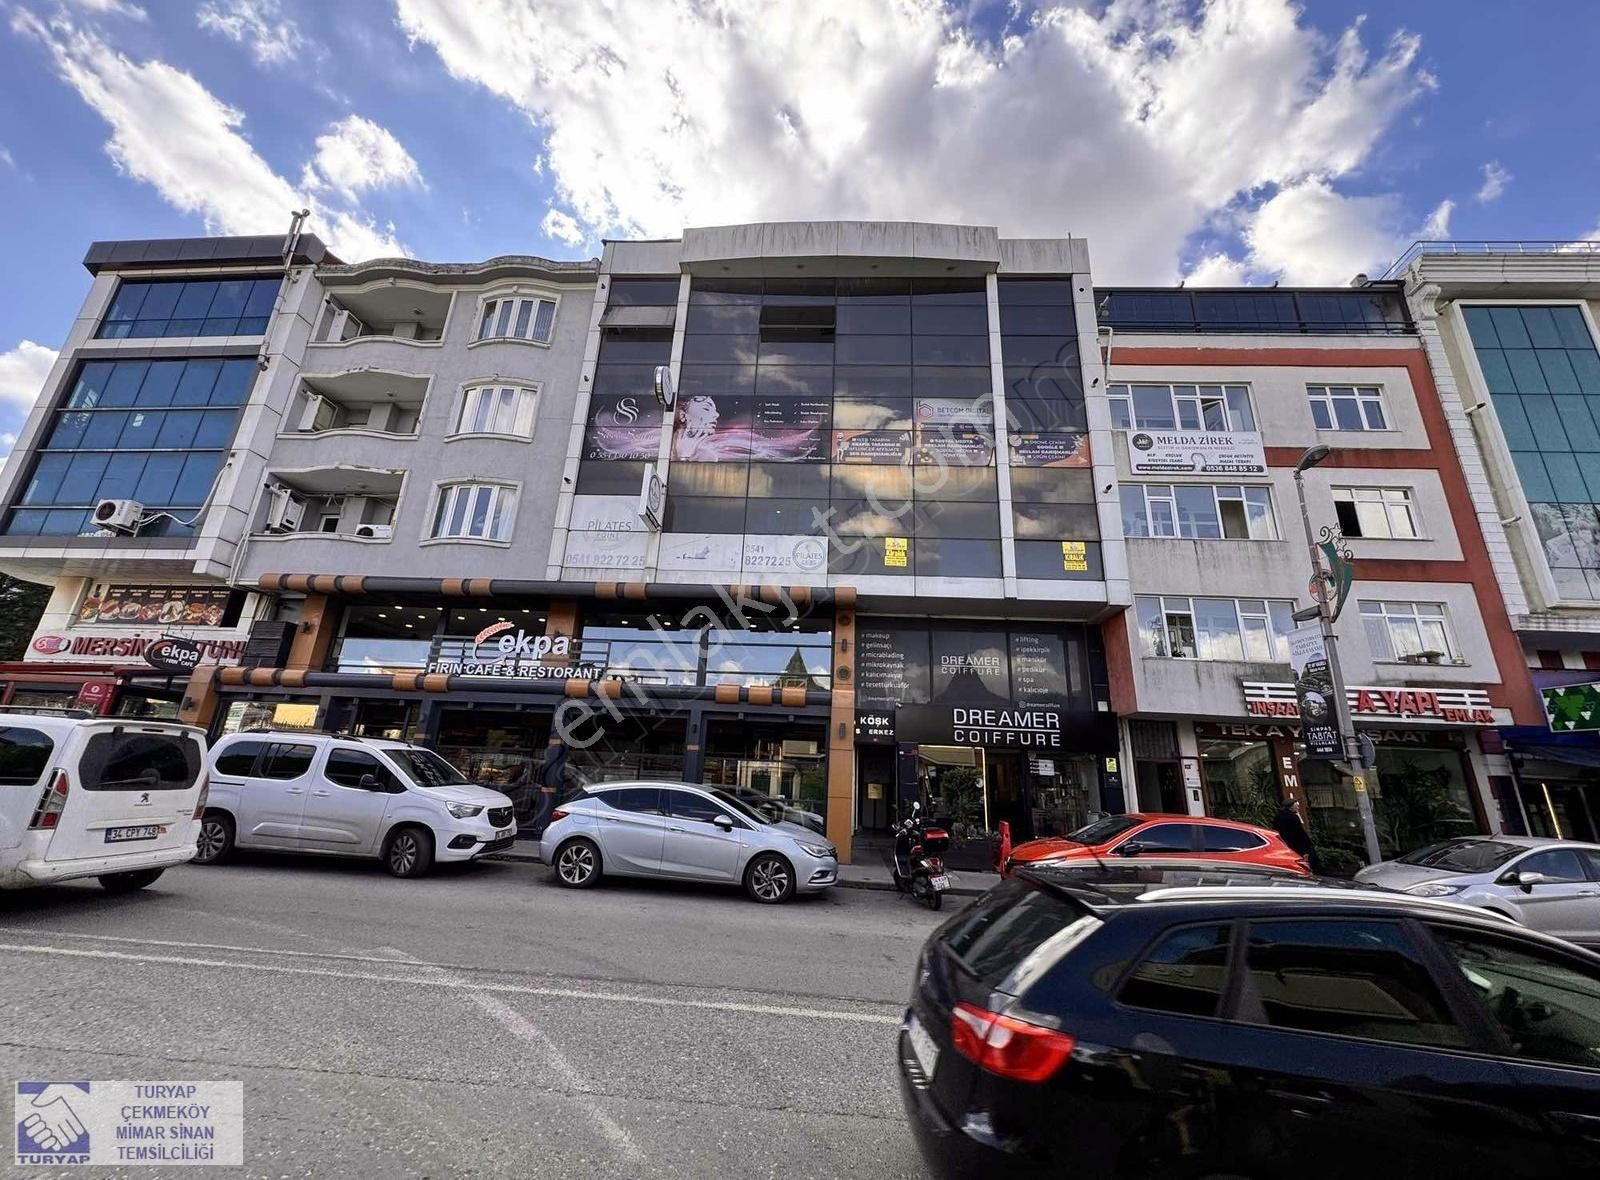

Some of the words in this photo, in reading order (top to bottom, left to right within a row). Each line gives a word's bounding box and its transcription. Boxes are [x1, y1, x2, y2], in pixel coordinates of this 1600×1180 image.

[1157, 436, 1197, 445] MELDA
[1200, 435, 1234, 445] ZİREK
[588, 520, 632, 531] PILATES
[744, 544, 765, 553] 0541
[593, 554, 614, 566] 822
[616, 554, 628, 567] 72
[631, 555, 646, 567] 25
[70, 636, 152, 658] MERSİN
[498, 629, 570, 660] ekpa
[161, 644, 199, 662] ekpa
[941, 655, 1000, 666] DREAMER
[466, 664, 500, 676] CAFE
[505, 666, 515, 676] &
[519, 666, 601, 679] RESTORANT
[941, 667, 1001, 676] COIFFURE
[1381, 690, 1441, 714] YAPI
[859, 714, 889, 728] KÖŞK
[953, 708, 1060, 729] DREAMER
[1443, 708, 1495, 723] EMLAK
[953, 730, 1061, 747] COIFFURE
[112, 829, 122, 839] 34
[126, 827, 140, 838] CPY
